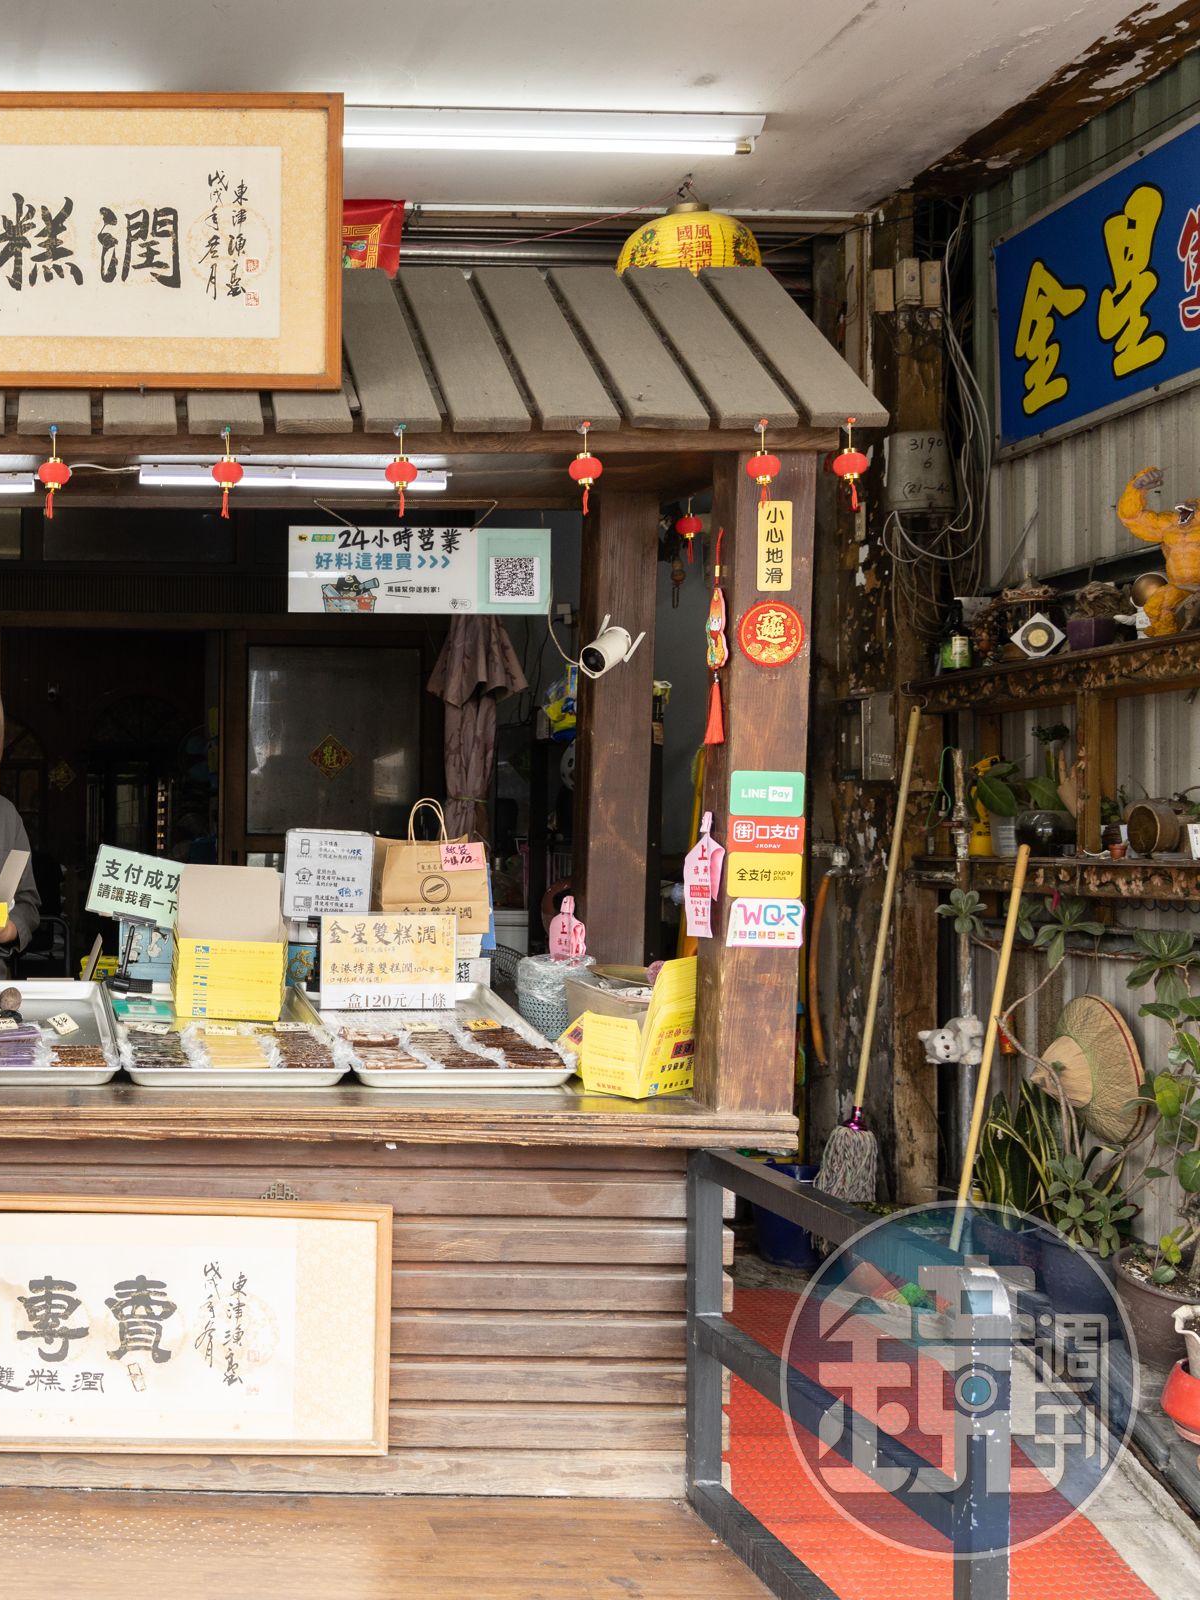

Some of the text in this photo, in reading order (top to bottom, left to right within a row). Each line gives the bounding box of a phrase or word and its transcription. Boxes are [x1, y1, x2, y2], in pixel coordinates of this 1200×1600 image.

[338, 527, 462, 554] 24小時營業
[765, 507, 784, 585] 小心地滑
[315, 552, 412, 570] 好料這裡買
[741, 788, 790, 800] LINE Pay
[735, 824, 800, 840] 街口支付
[102, 859, 180, 893] 支付成功
[736, 868, 772, 882] 全支付
[96, 882, 178, 914] 請讓我看一下
[328, 920, 437, 946] 金星雙糕潤
